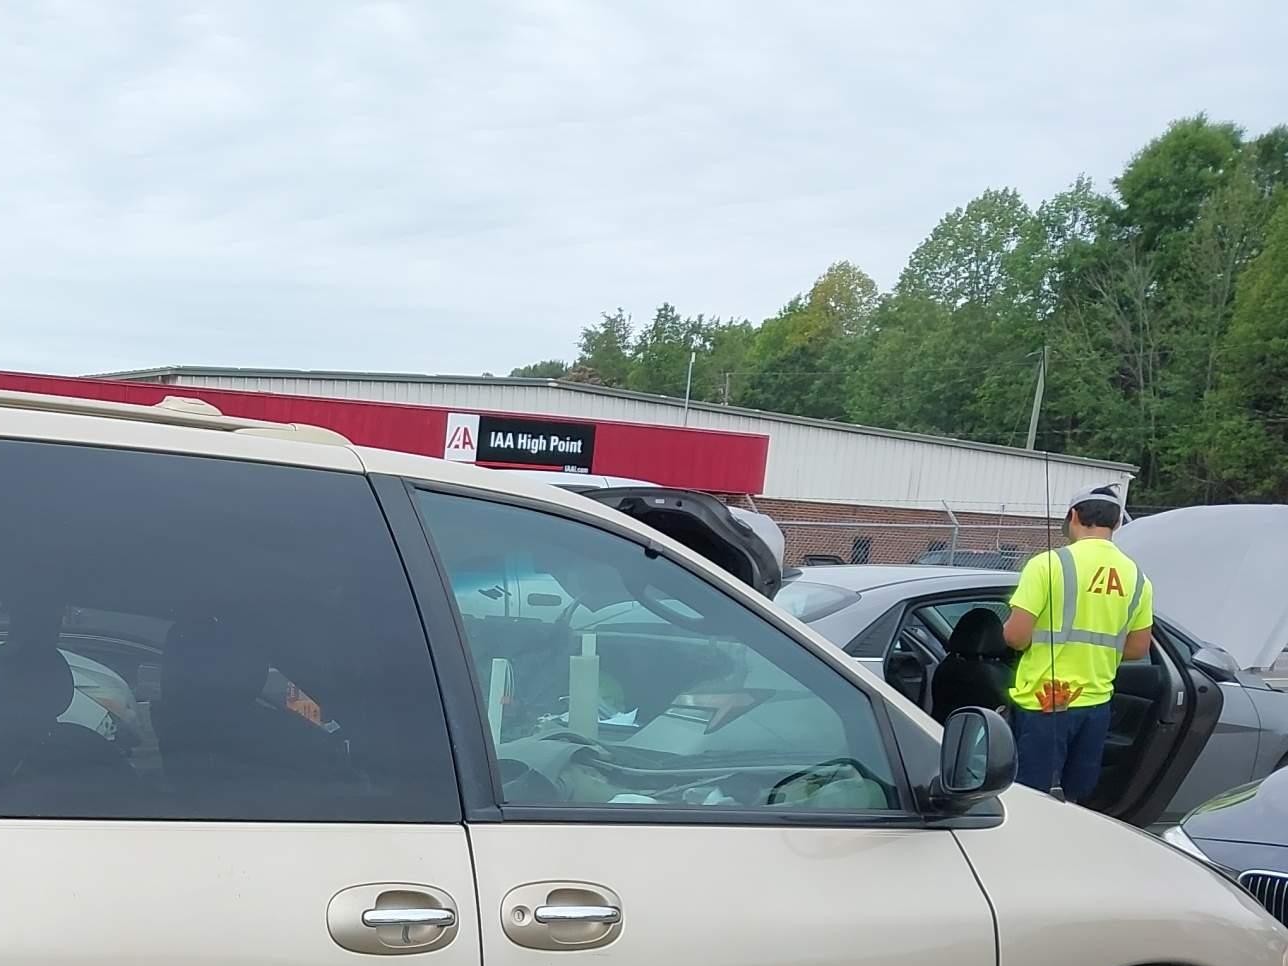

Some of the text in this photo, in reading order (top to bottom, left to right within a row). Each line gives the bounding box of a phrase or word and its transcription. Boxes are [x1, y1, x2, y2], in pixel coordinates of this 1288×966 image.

[490, 431, 582, 454] IAA High Point
